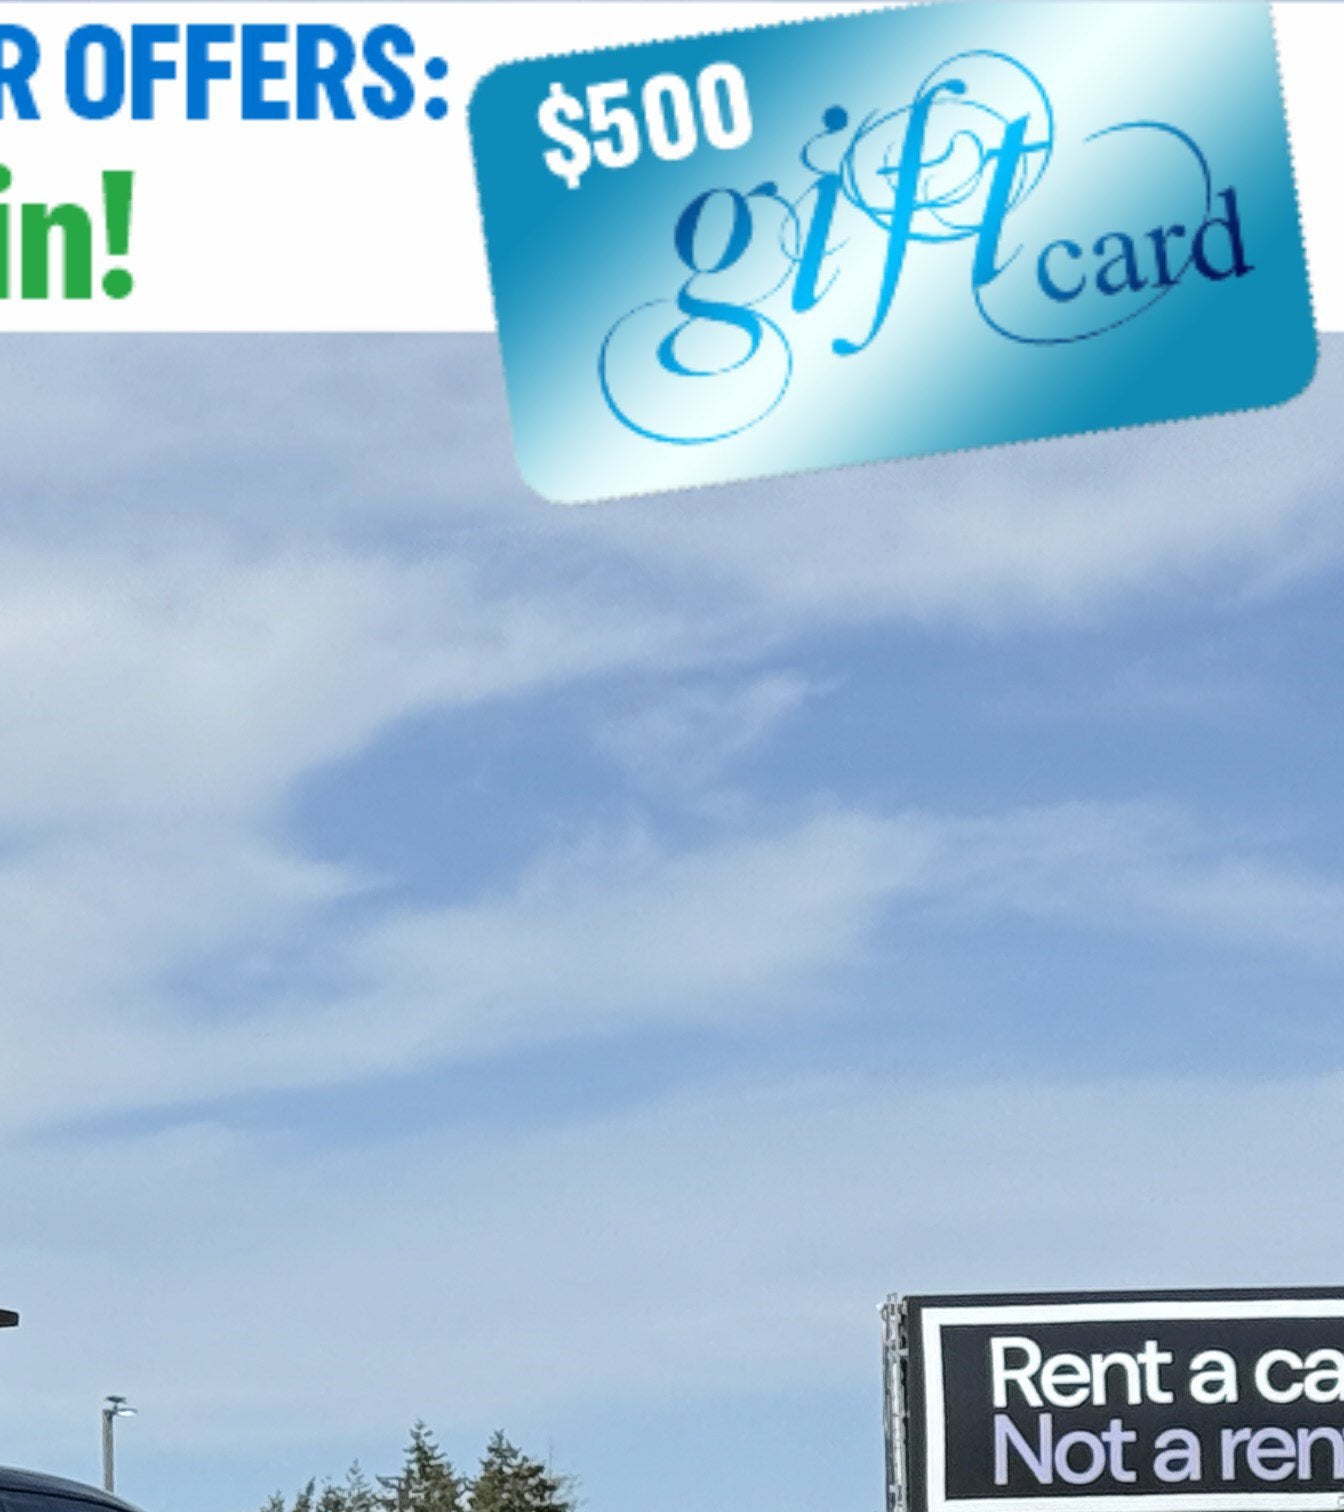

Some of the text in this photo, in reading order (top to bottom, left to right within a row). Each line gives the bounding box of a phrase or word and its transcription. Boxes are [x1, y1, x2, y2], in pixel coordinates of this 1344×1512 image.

[990, 1335, 1174, 1409] Rent
[1189, 1349, 1239, 1405] a
[994, 1412, 1344, 1486] Not a ren
